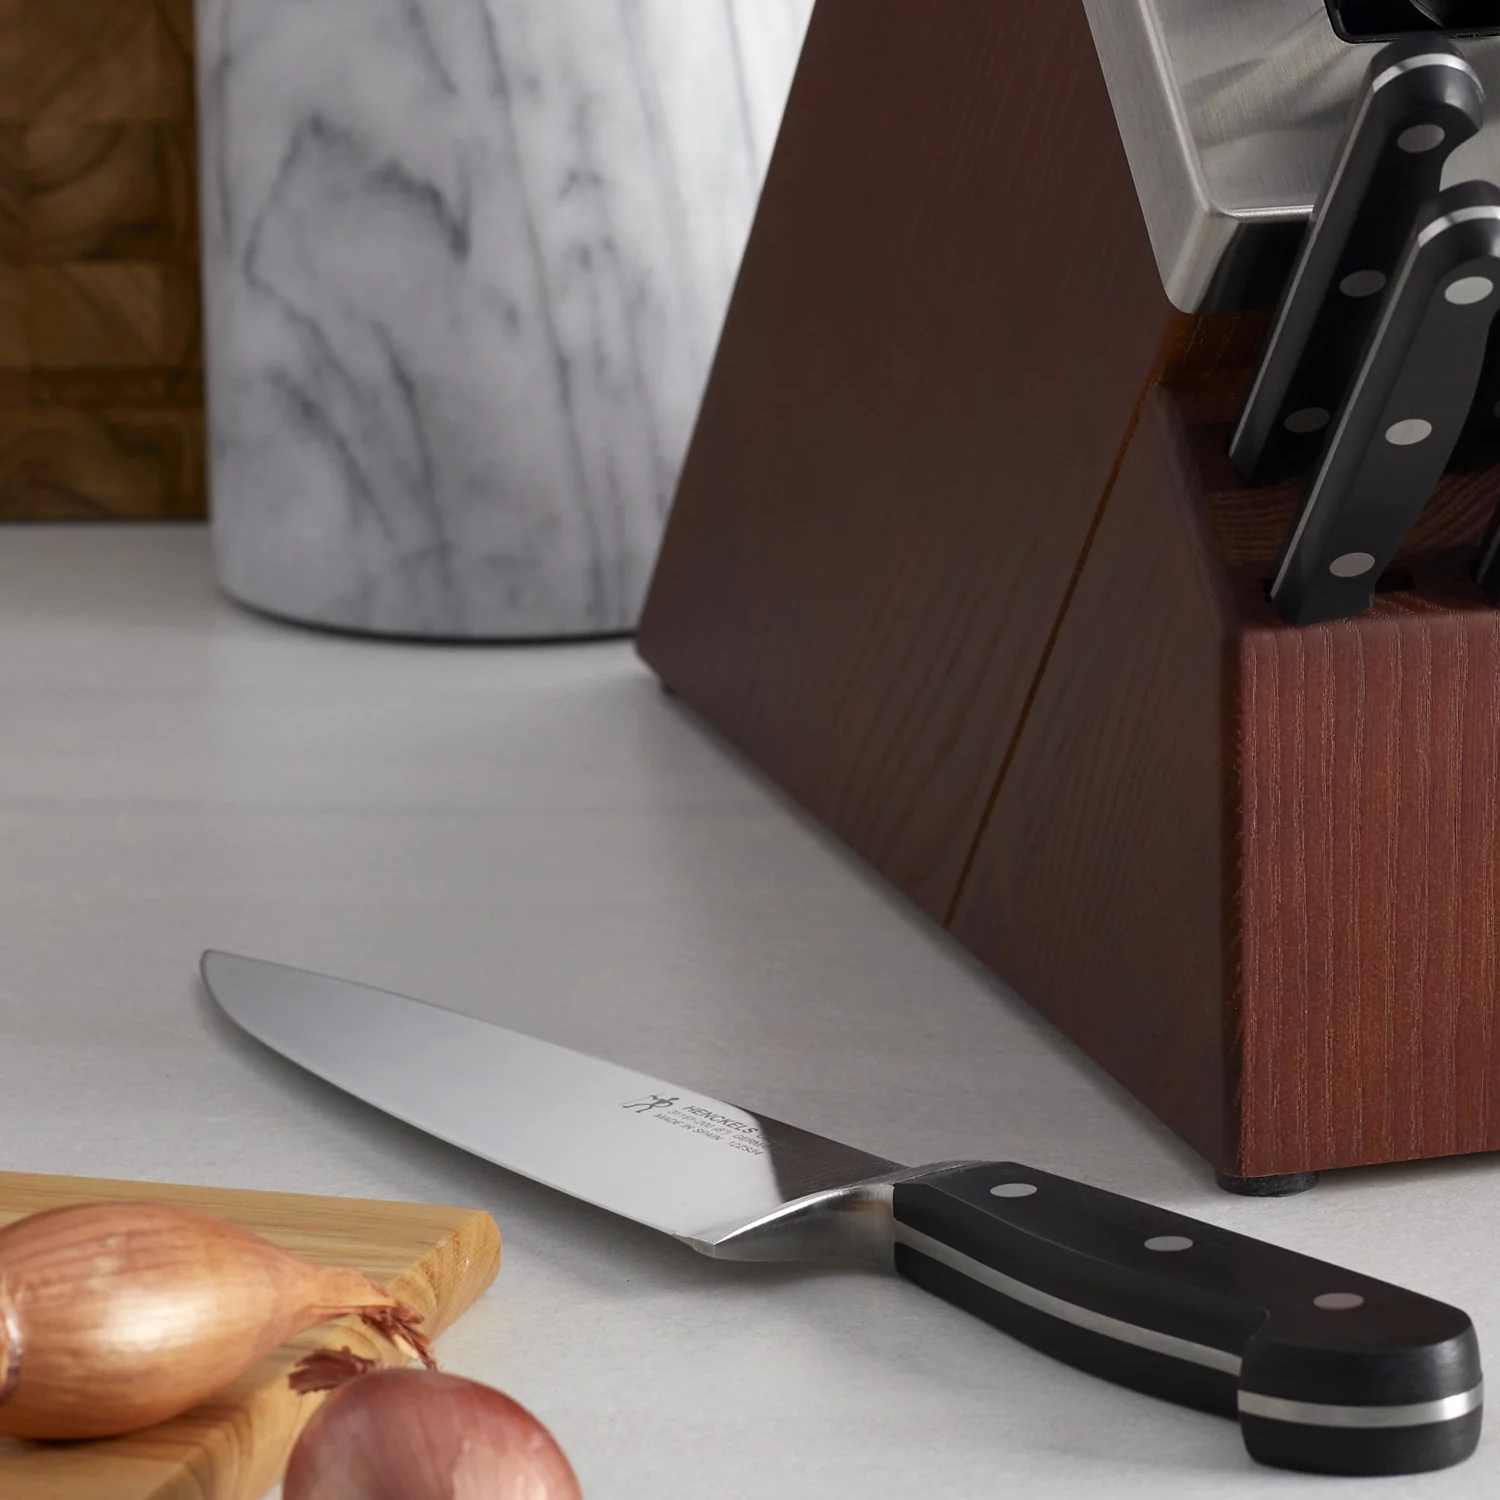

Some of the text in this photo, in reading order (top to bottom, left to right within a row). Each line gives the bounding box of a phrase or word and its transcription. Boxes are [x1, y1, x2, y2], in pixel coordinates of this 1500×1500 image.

[653, 1113, 685, 1126] MADE
[692, 1128, 724, 1141] SPAIN
[681, 1104, 759, 1134] HENCKELS
